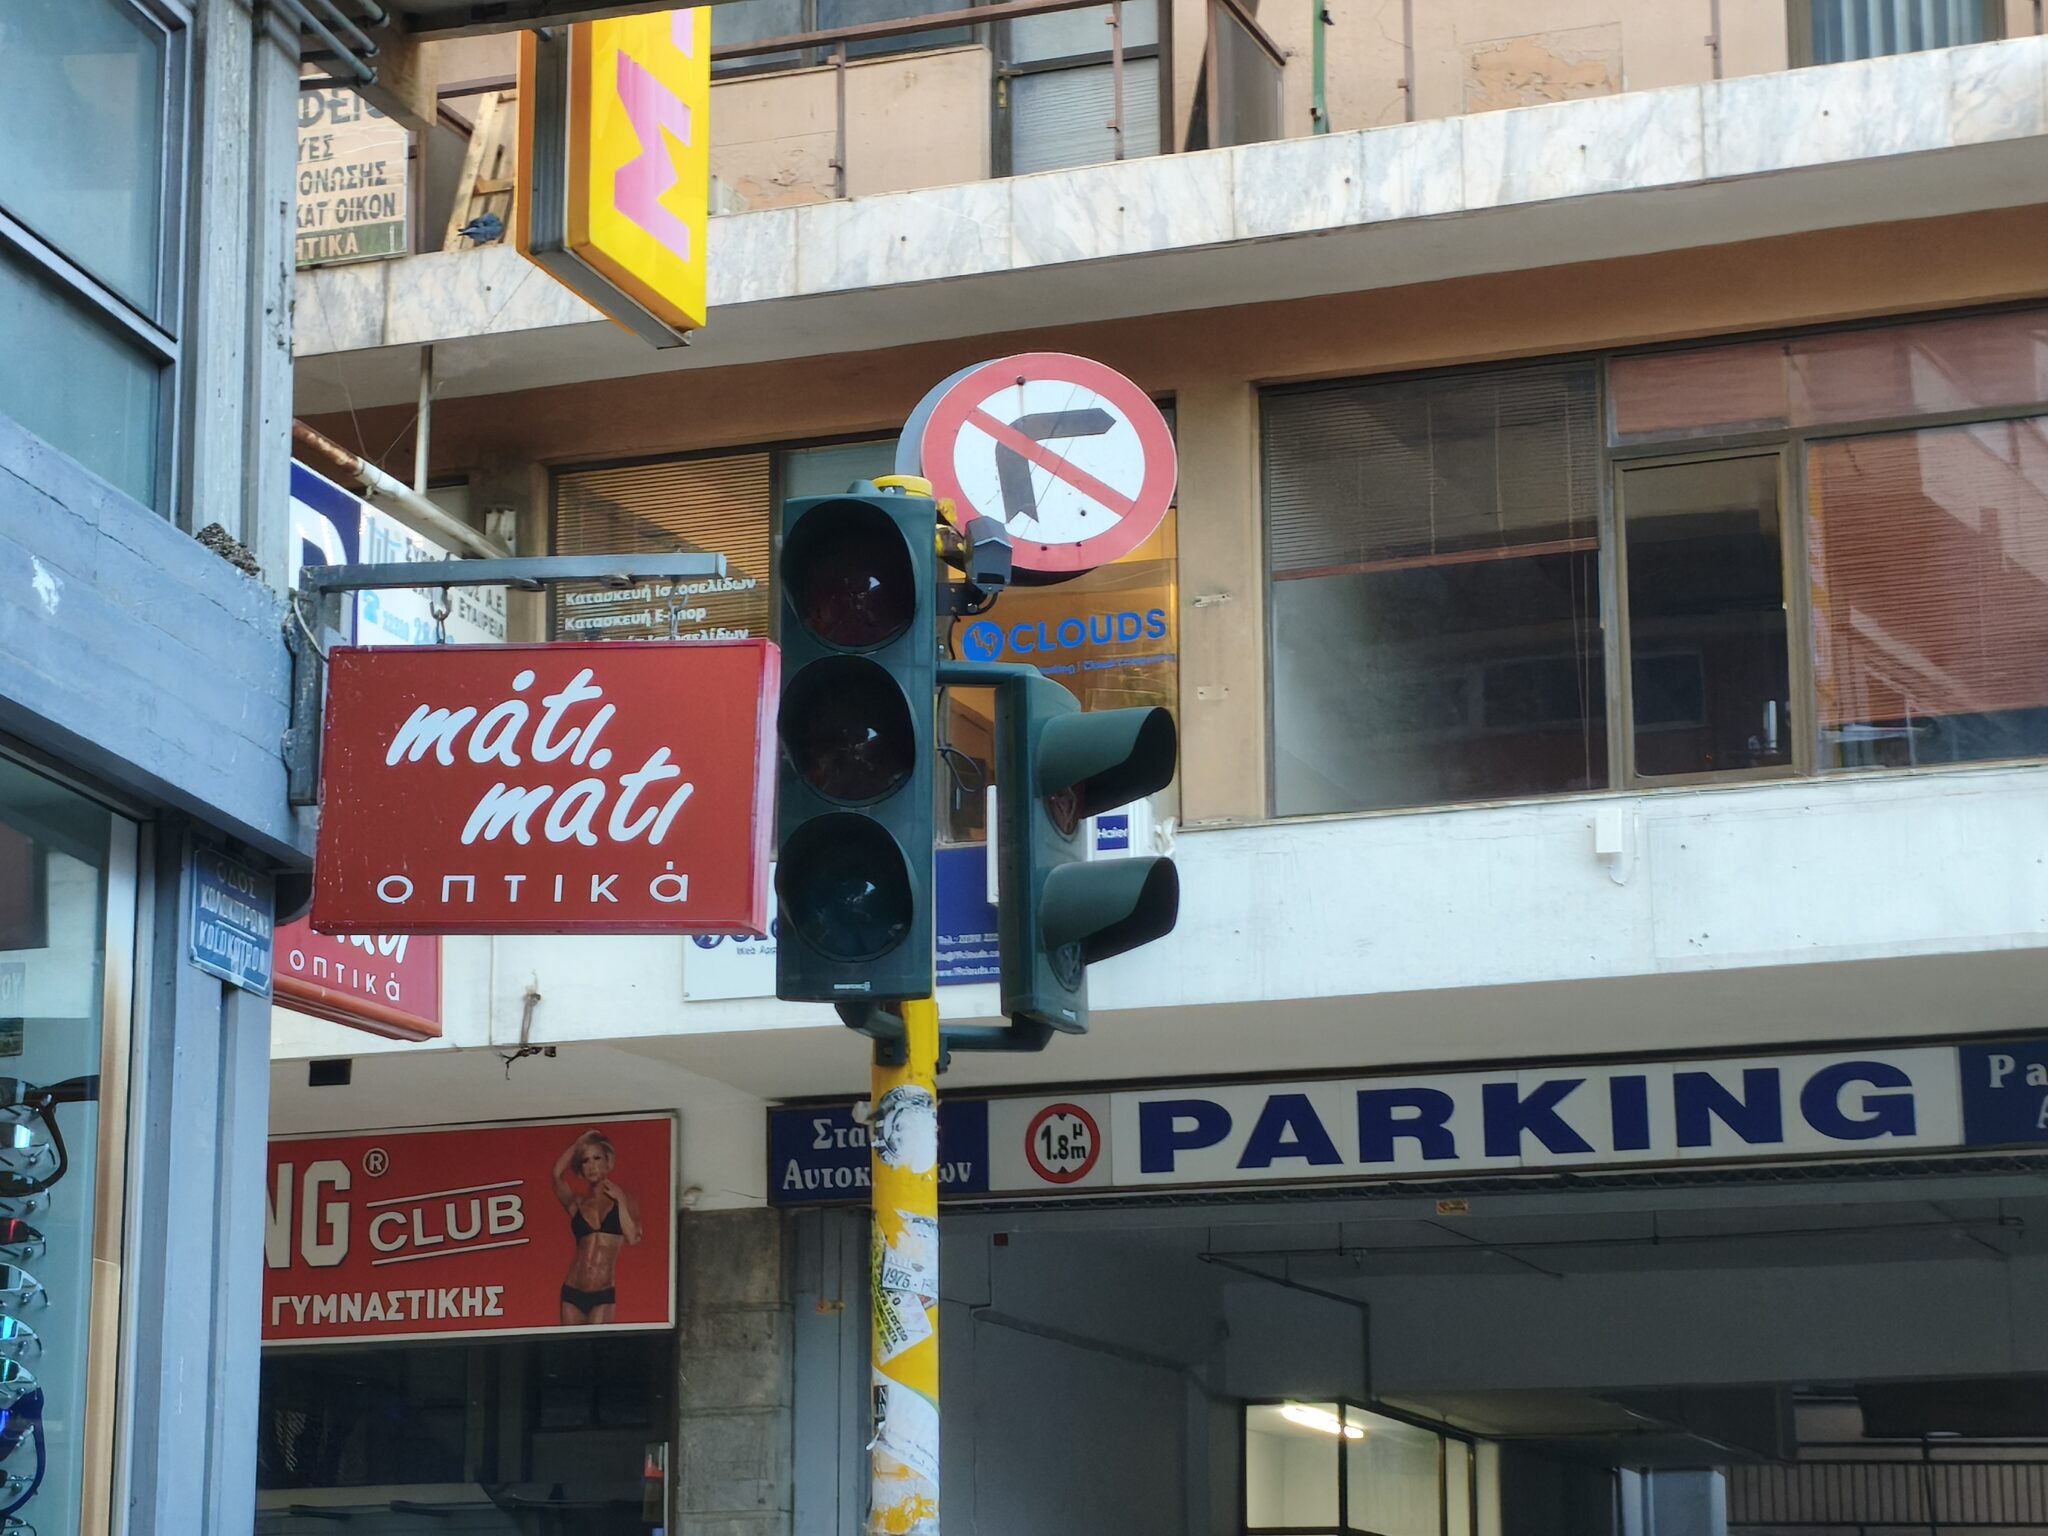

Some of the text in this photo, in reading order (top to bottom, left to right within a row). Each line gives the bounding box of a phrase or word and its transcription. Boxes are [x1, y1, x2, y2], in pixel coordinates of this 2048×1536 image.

[565, 576, 756, 606] Κατασκευή Ισοσελίδων
[565, 610, 652, 630] Κατασκευή
[1008, 608, 1168, 654] CLOUDS
[1139, 1060, 1918, 1174] PARKING
[368, 1193, 525, 1252] CLUB
[271, 1285, 504, 1327] ΓΥΜΝΑΣΤΙΚΗΣ
